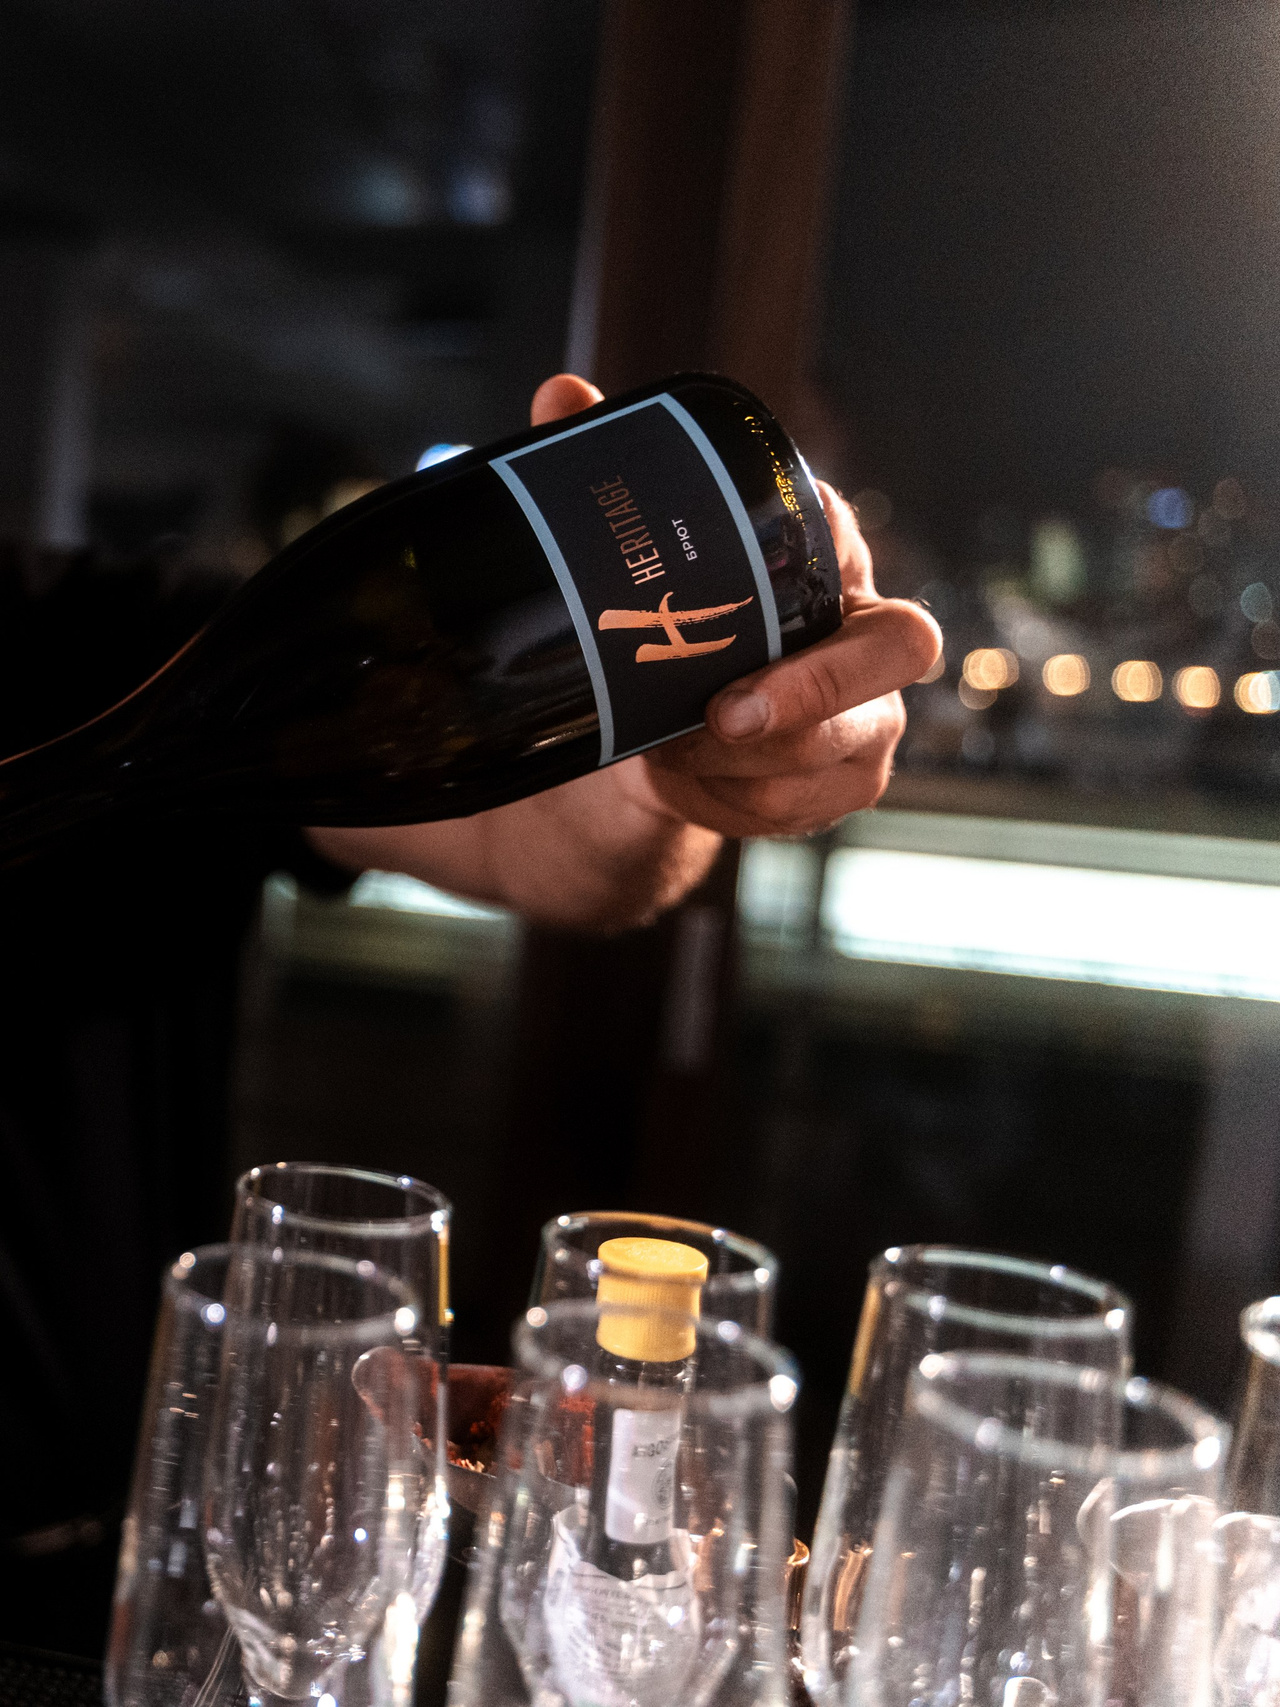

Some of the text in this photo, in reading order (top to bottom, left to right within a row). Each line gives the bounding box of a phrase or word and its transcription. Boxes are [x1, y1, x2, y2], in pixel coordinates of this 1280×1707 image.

[590, 475, 666, 585] HERITAGE
[671, 519, 698, 561] БРЮТ
[599, 592, 754, 663] H
